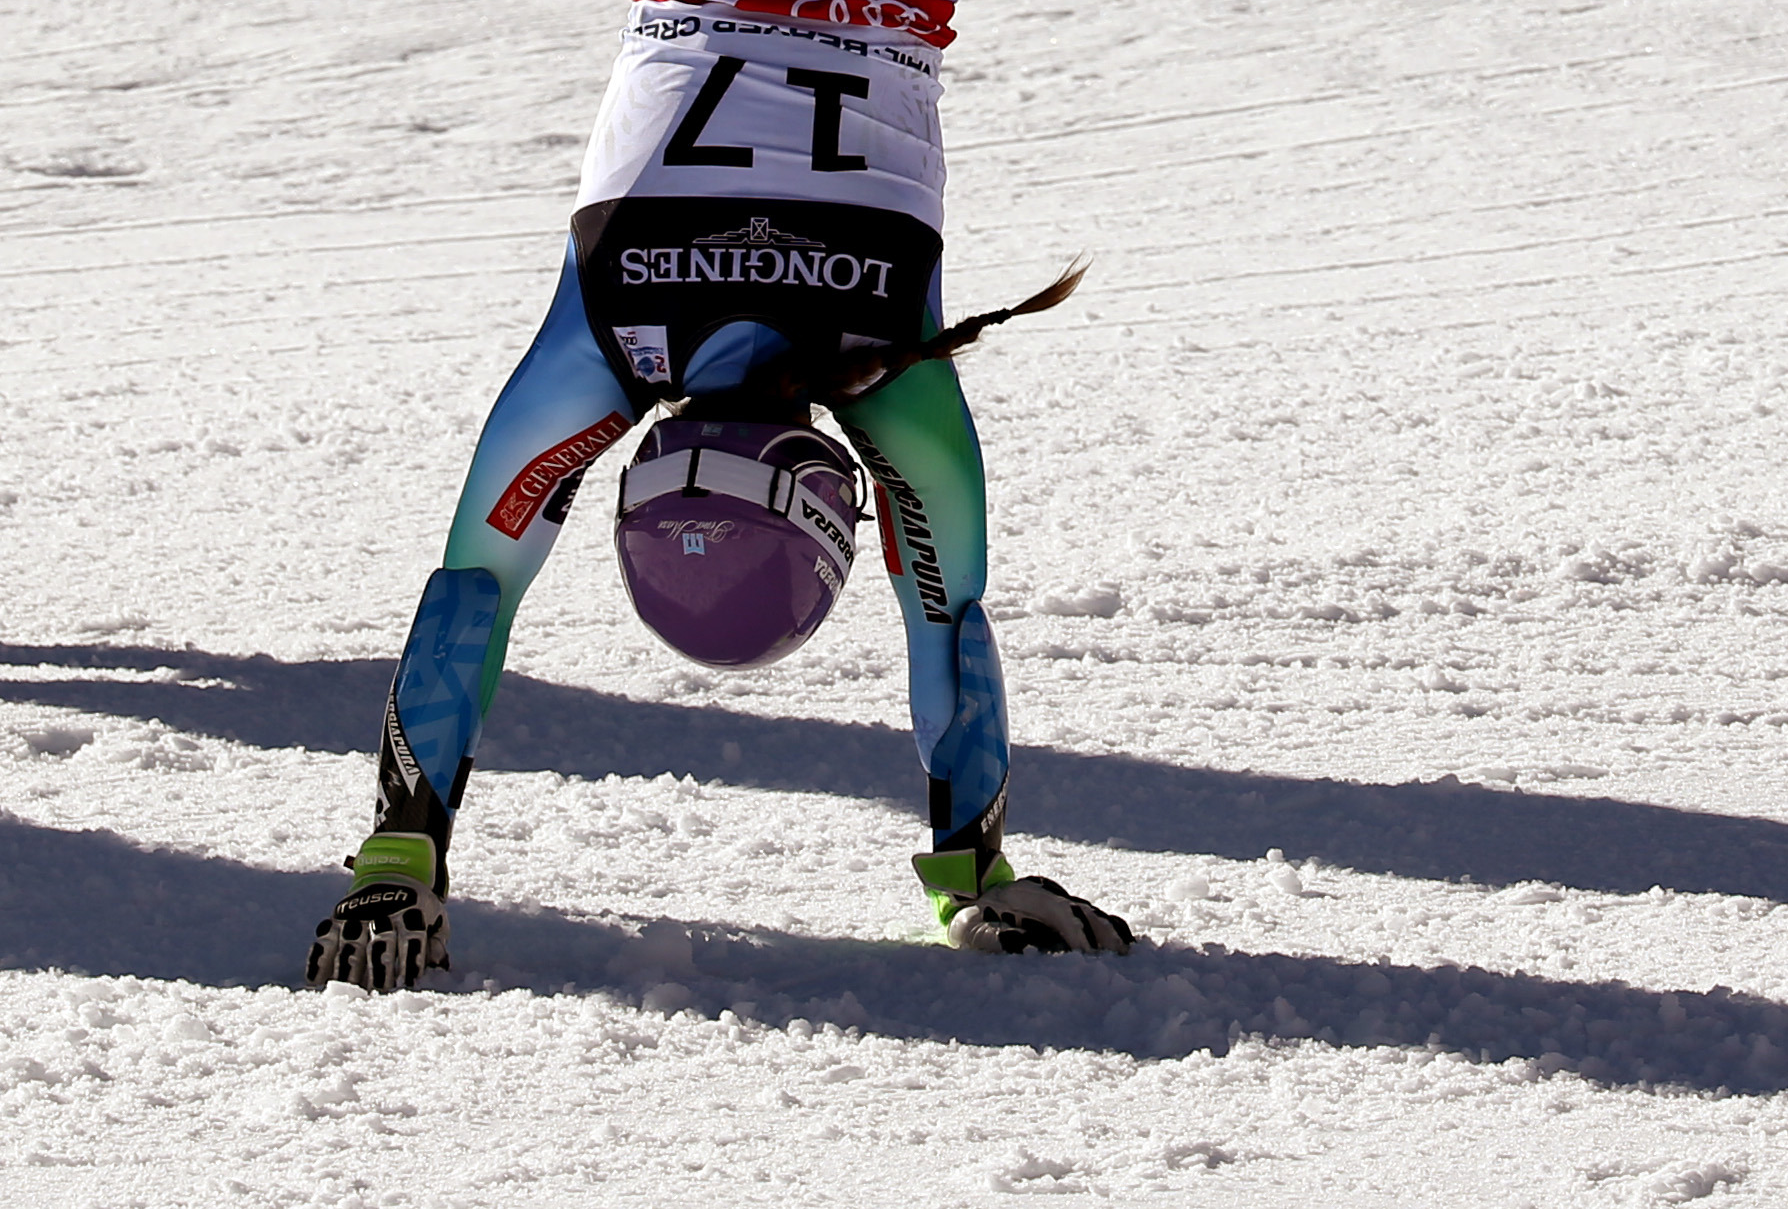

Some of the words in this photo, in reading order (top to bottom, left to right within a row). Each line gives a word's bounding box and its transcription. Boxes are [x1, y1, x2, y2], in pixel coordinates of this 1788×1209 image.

[662, 55, 870, 172] 17
[622, 247, 893, 298] LONGINES
[520, 421, 623, 498] GENERALI
[850, 425, 953, 625] ENERGIAPURA
[356, 854, 411, 866] racing
[336, 889, 409, 914] reusch
